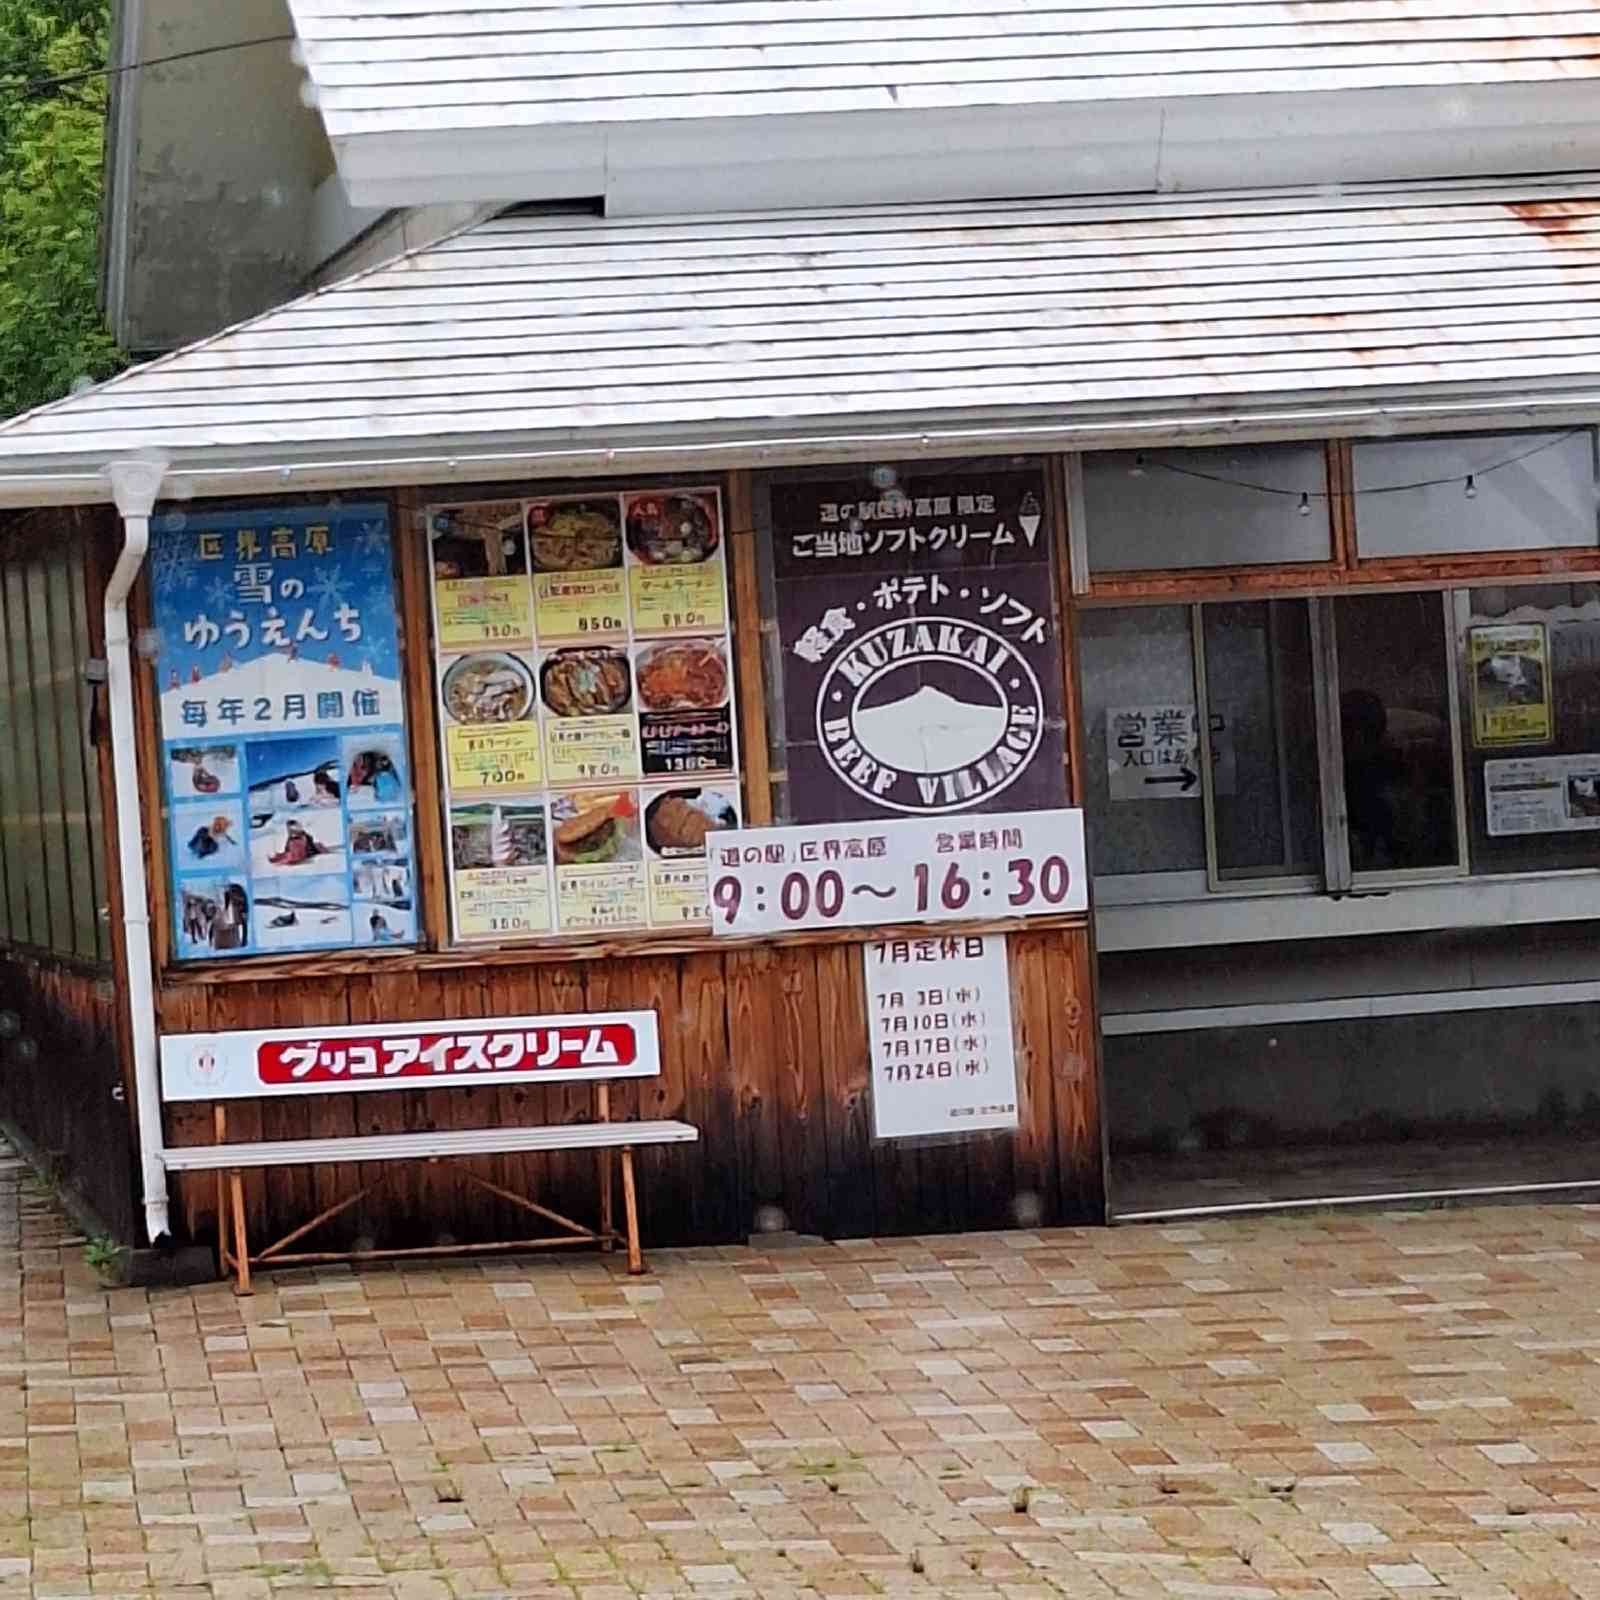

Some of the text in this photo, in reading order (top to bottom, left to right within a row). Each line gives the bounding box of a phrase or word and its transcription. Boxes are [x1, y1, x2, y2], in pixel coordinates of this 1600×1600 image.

[199, 526, 333, 561] 区界高原
[792, 522, 1015, 559] ご当地ソフトクリーム
[233, 562, 305, 605] 雪の
[183, 603, 363, 650] ゆうえんち
[836, 625, 1011, 687] KUZAKAI
[181, 689, 381, 728] 毎年2月開催
[823, 703, 1037, 805] BEEF VILLAGE
[935, 827, 1025, 854] 営業時間
[873, 936, 984, 965] 7月定休日
[279, 1029, 619, 1079] グリコアイスクリーム
